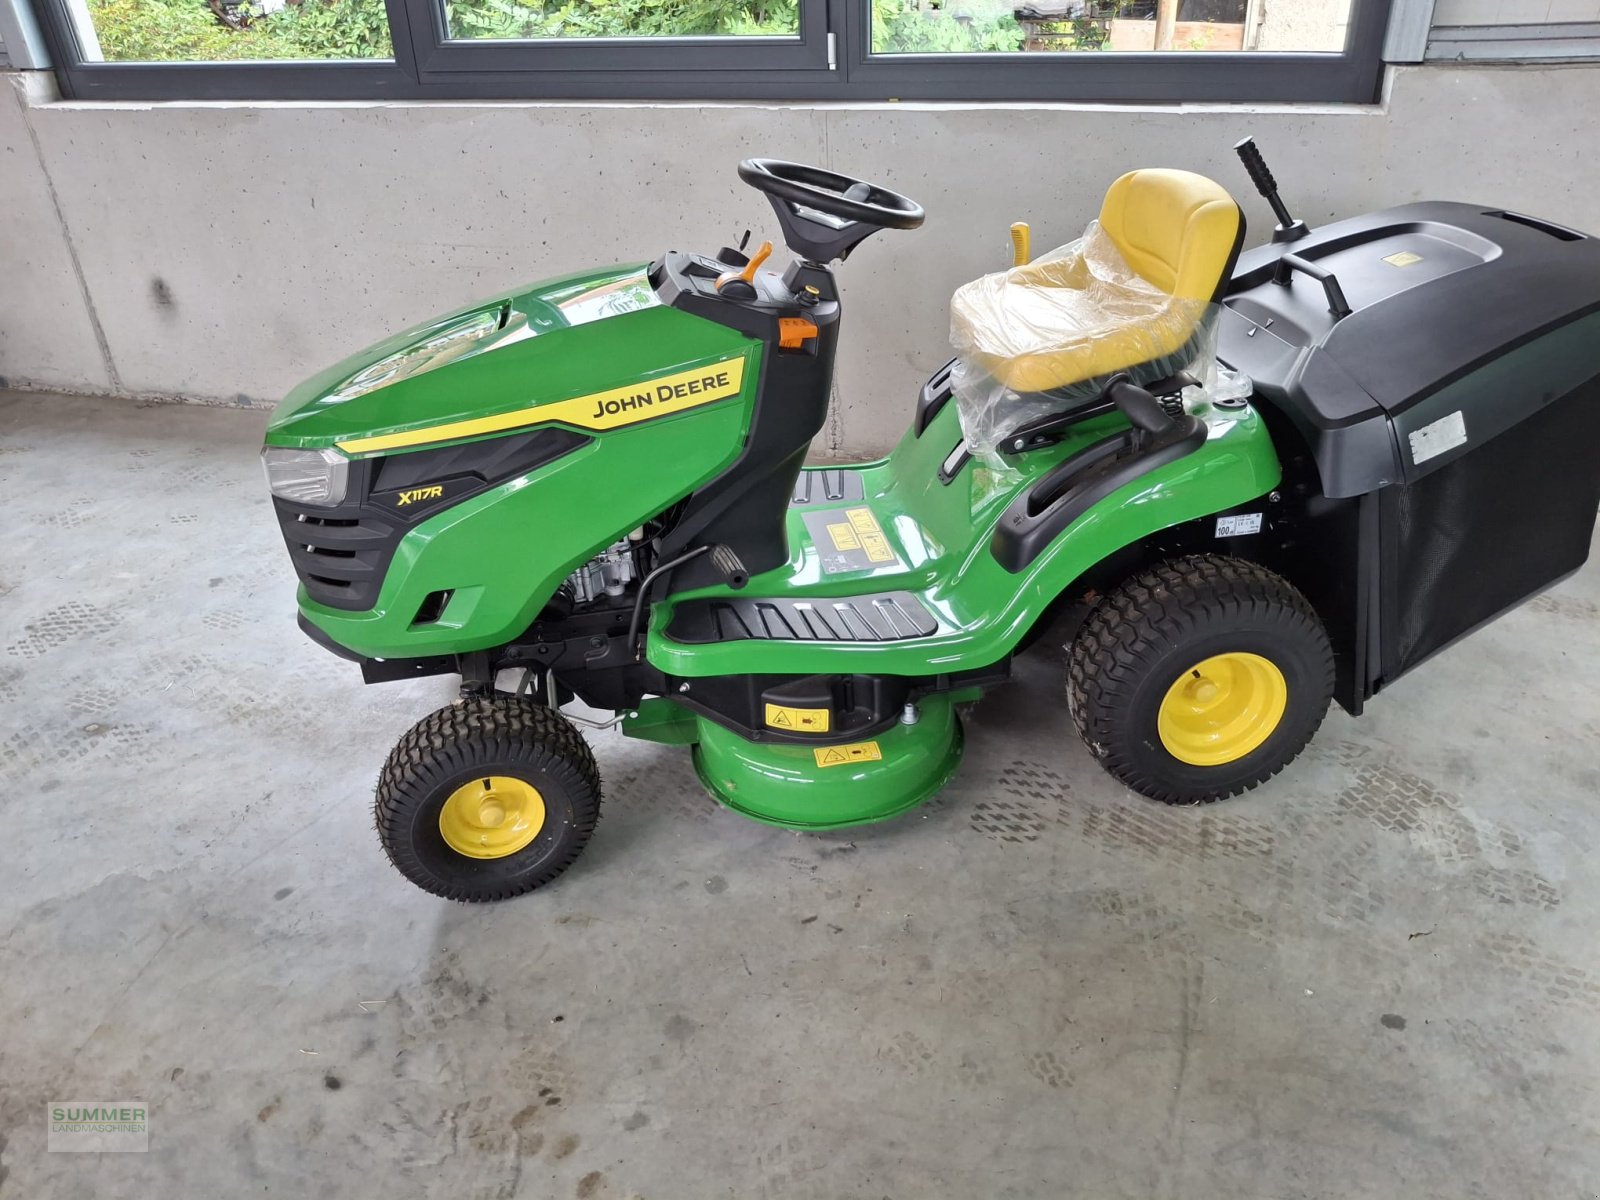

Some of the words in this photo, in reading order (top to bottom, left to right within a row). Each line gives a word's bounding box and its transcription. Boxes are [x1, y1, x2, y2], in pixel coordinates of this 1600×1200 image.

[593, 392, 652, 418] JOHN
[656, 372, 729, 402] DEERE
[397, 485, 443, 506] X117R
[1218, 526, 1230, 536] 100
